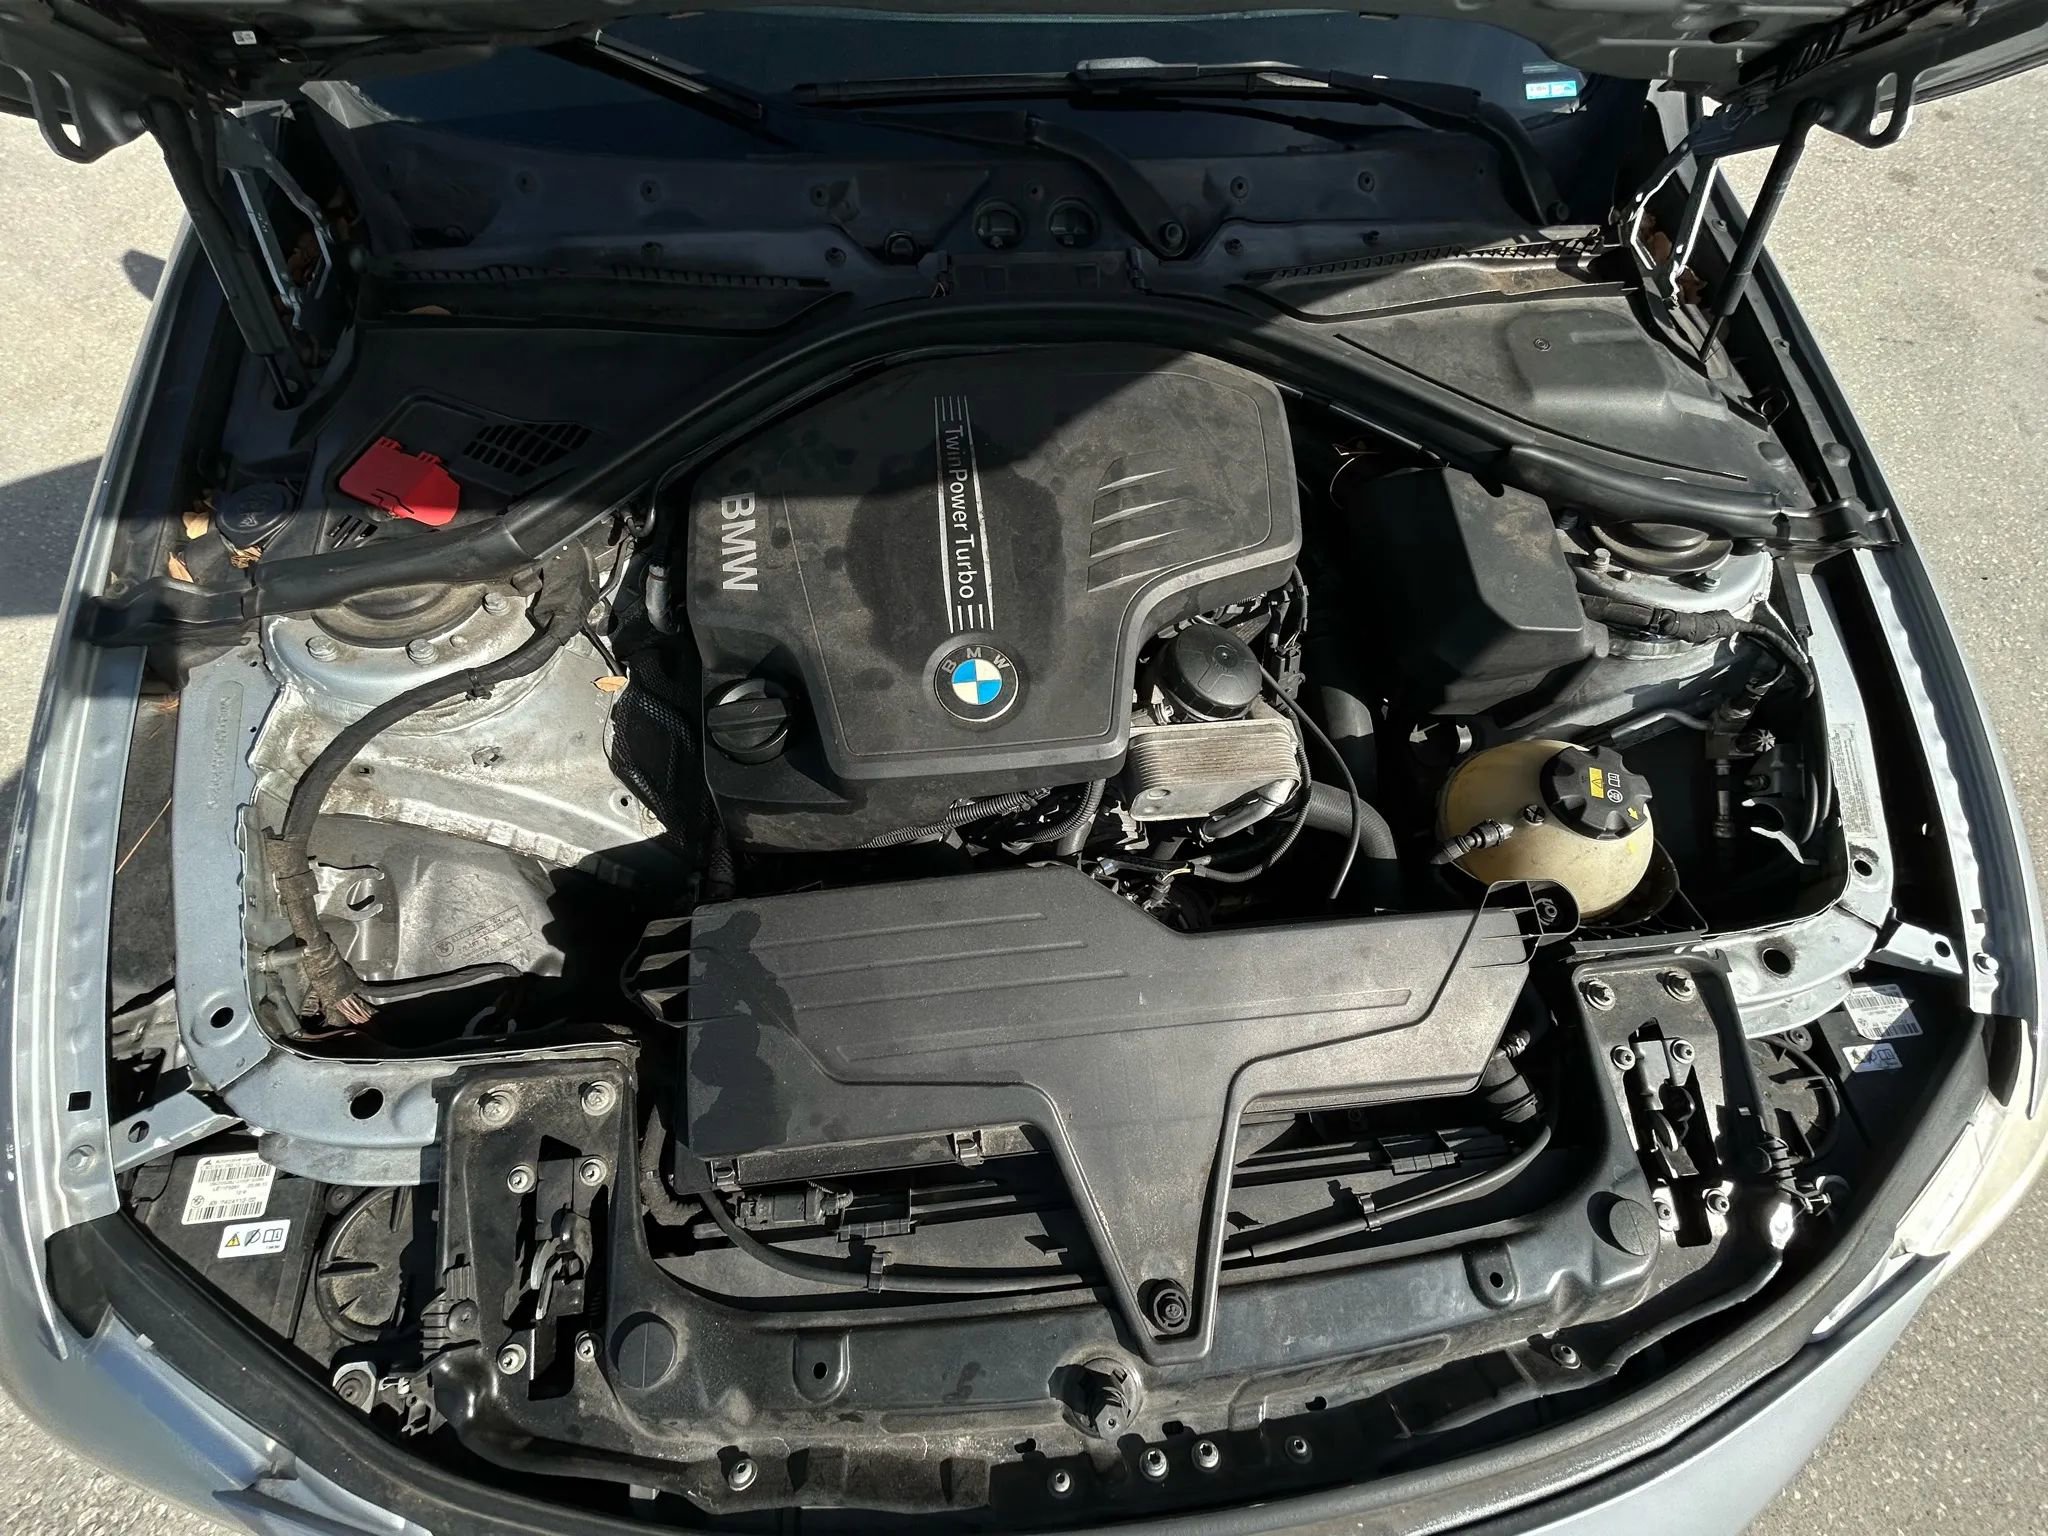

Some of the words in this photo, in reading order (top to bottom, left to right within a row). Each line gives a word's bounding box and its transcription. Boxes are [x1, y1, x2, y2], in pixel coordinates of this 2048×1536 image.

[945, 425, 968, 531] TwinPower
[721, 491, 758, 591] BMW
[955, 533, 978, 599] Turbo
[941, 647, 1010, 674] BMW
